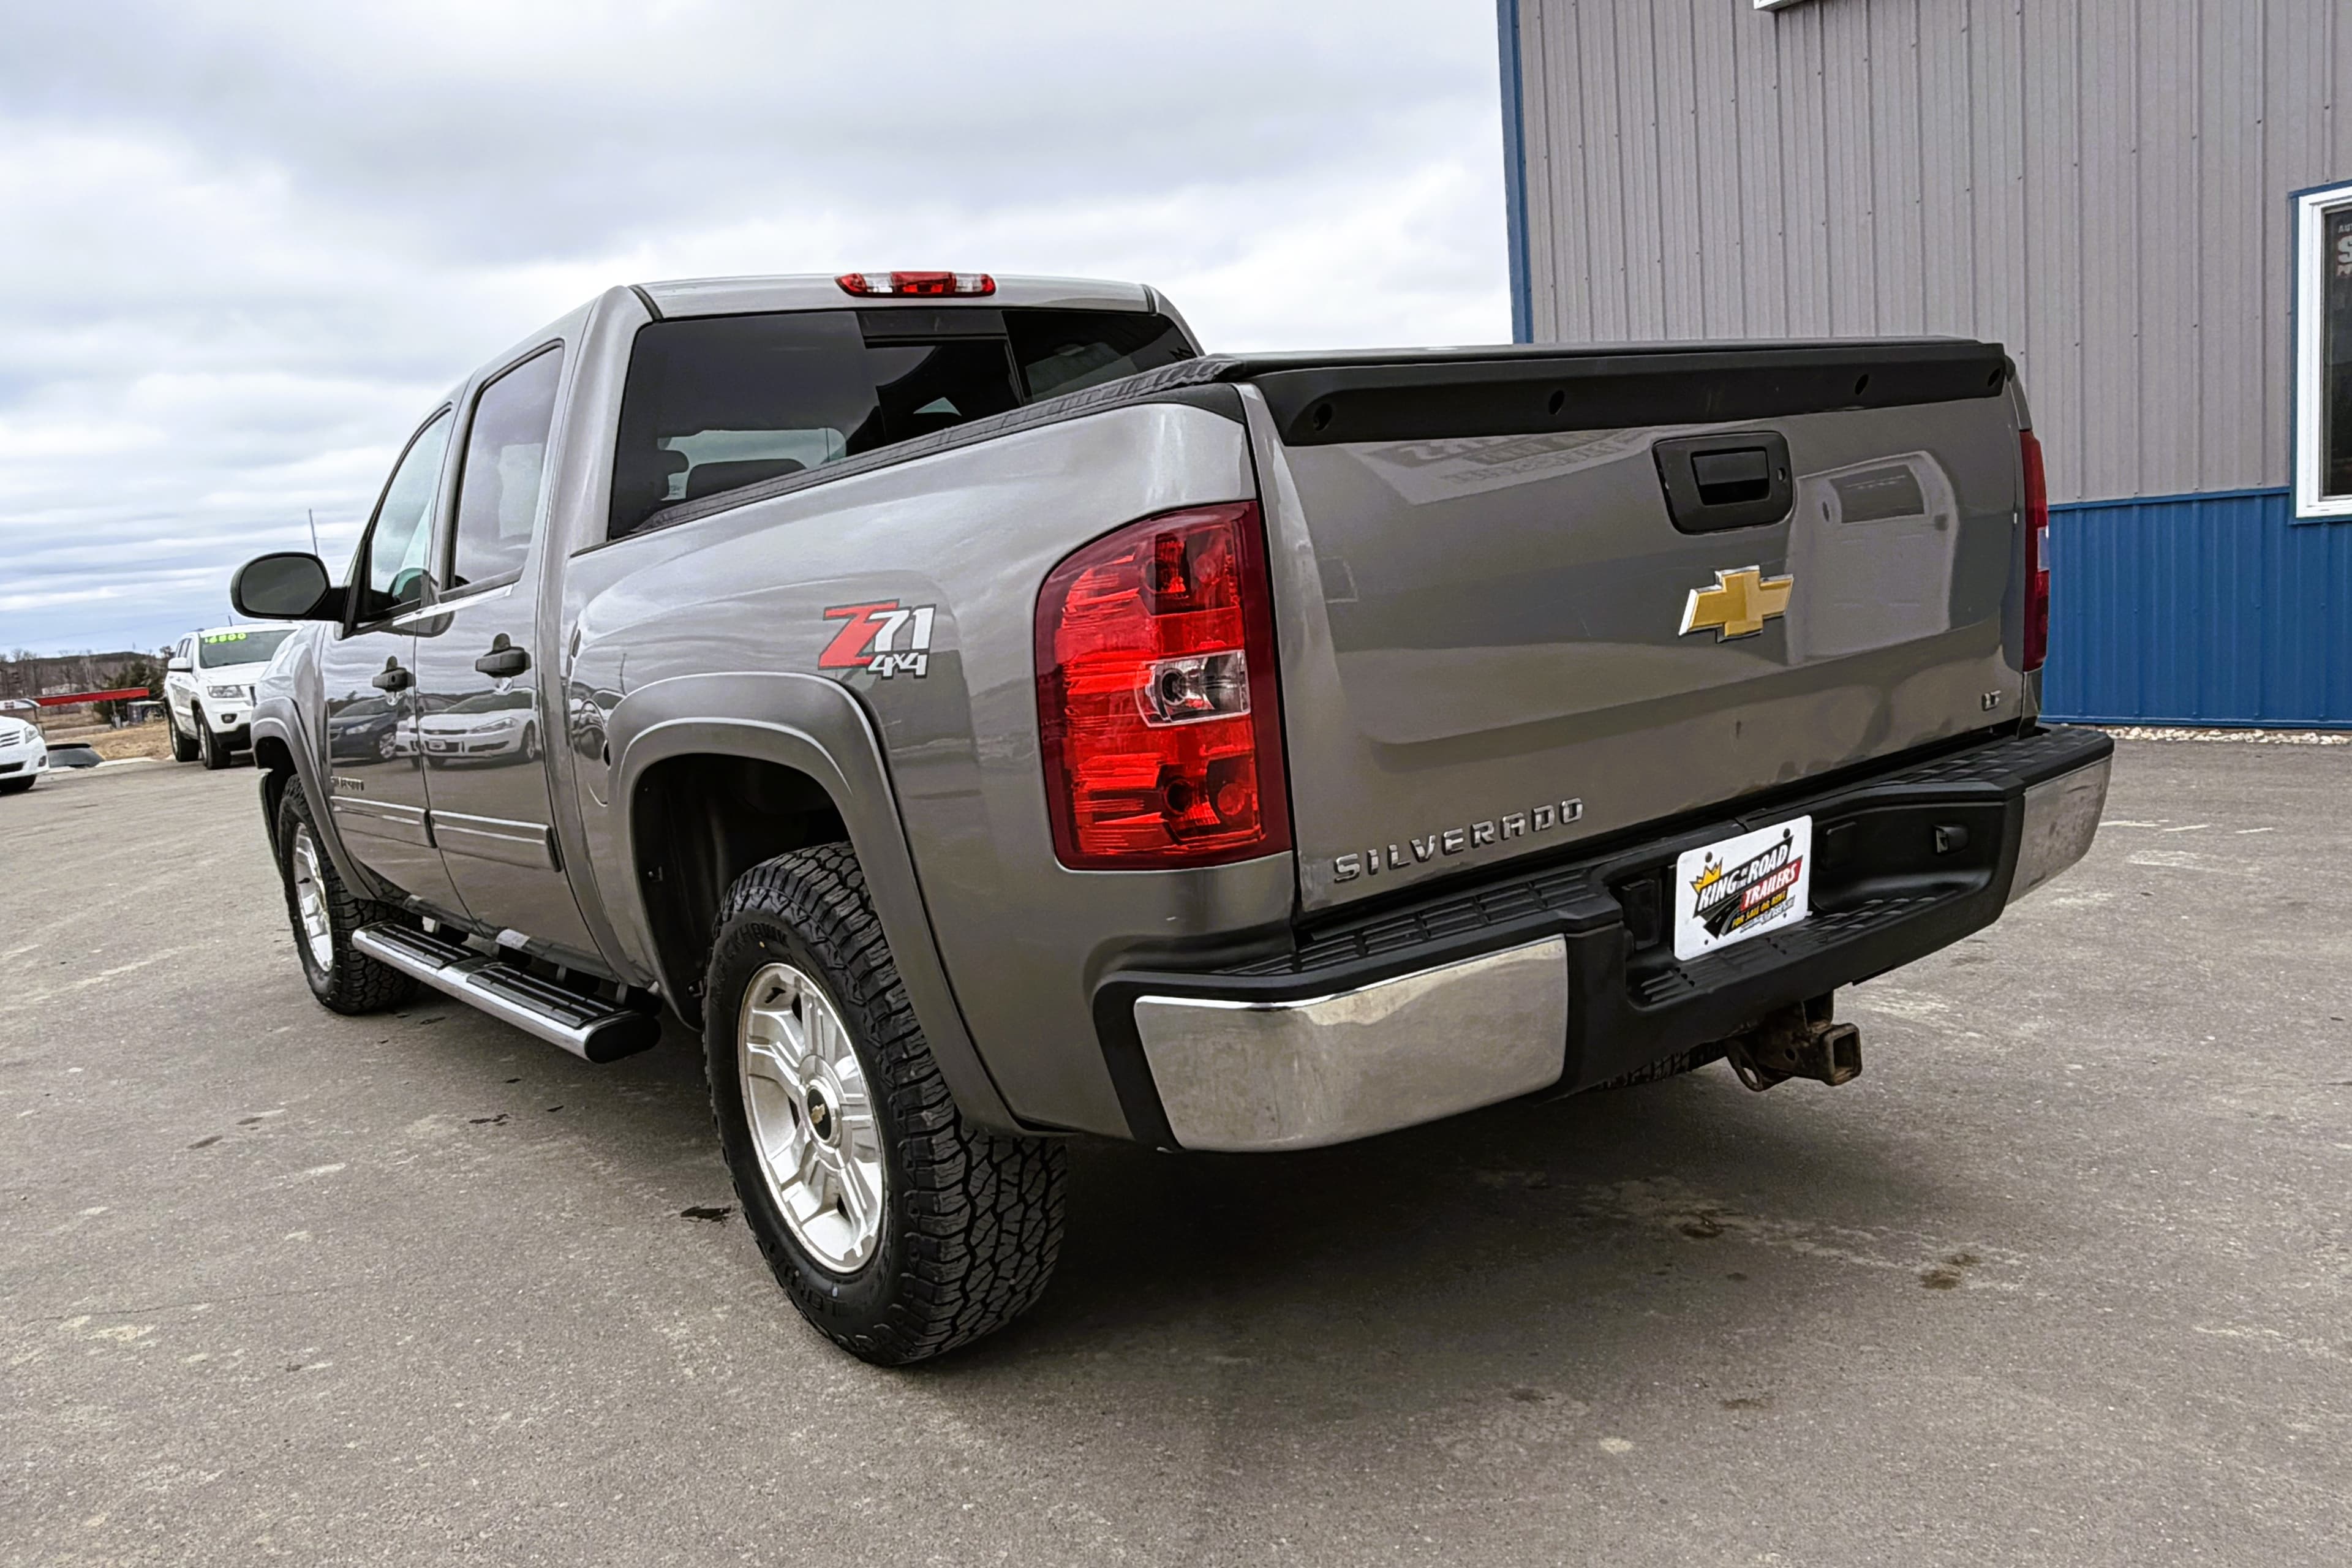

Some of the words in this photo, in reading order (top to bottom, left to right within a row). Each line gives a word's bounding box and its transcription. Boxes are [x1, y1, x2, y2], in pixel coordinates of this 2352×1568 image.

[818, 598, 937, 670] Z71
[1334, 797, 1583, 883] SILVERADO
[1697, 869, 1740, 911] KING
[1747, 844, 1789, 884] ROAD
[1744, 862, 1798, 909] TRAILERS
